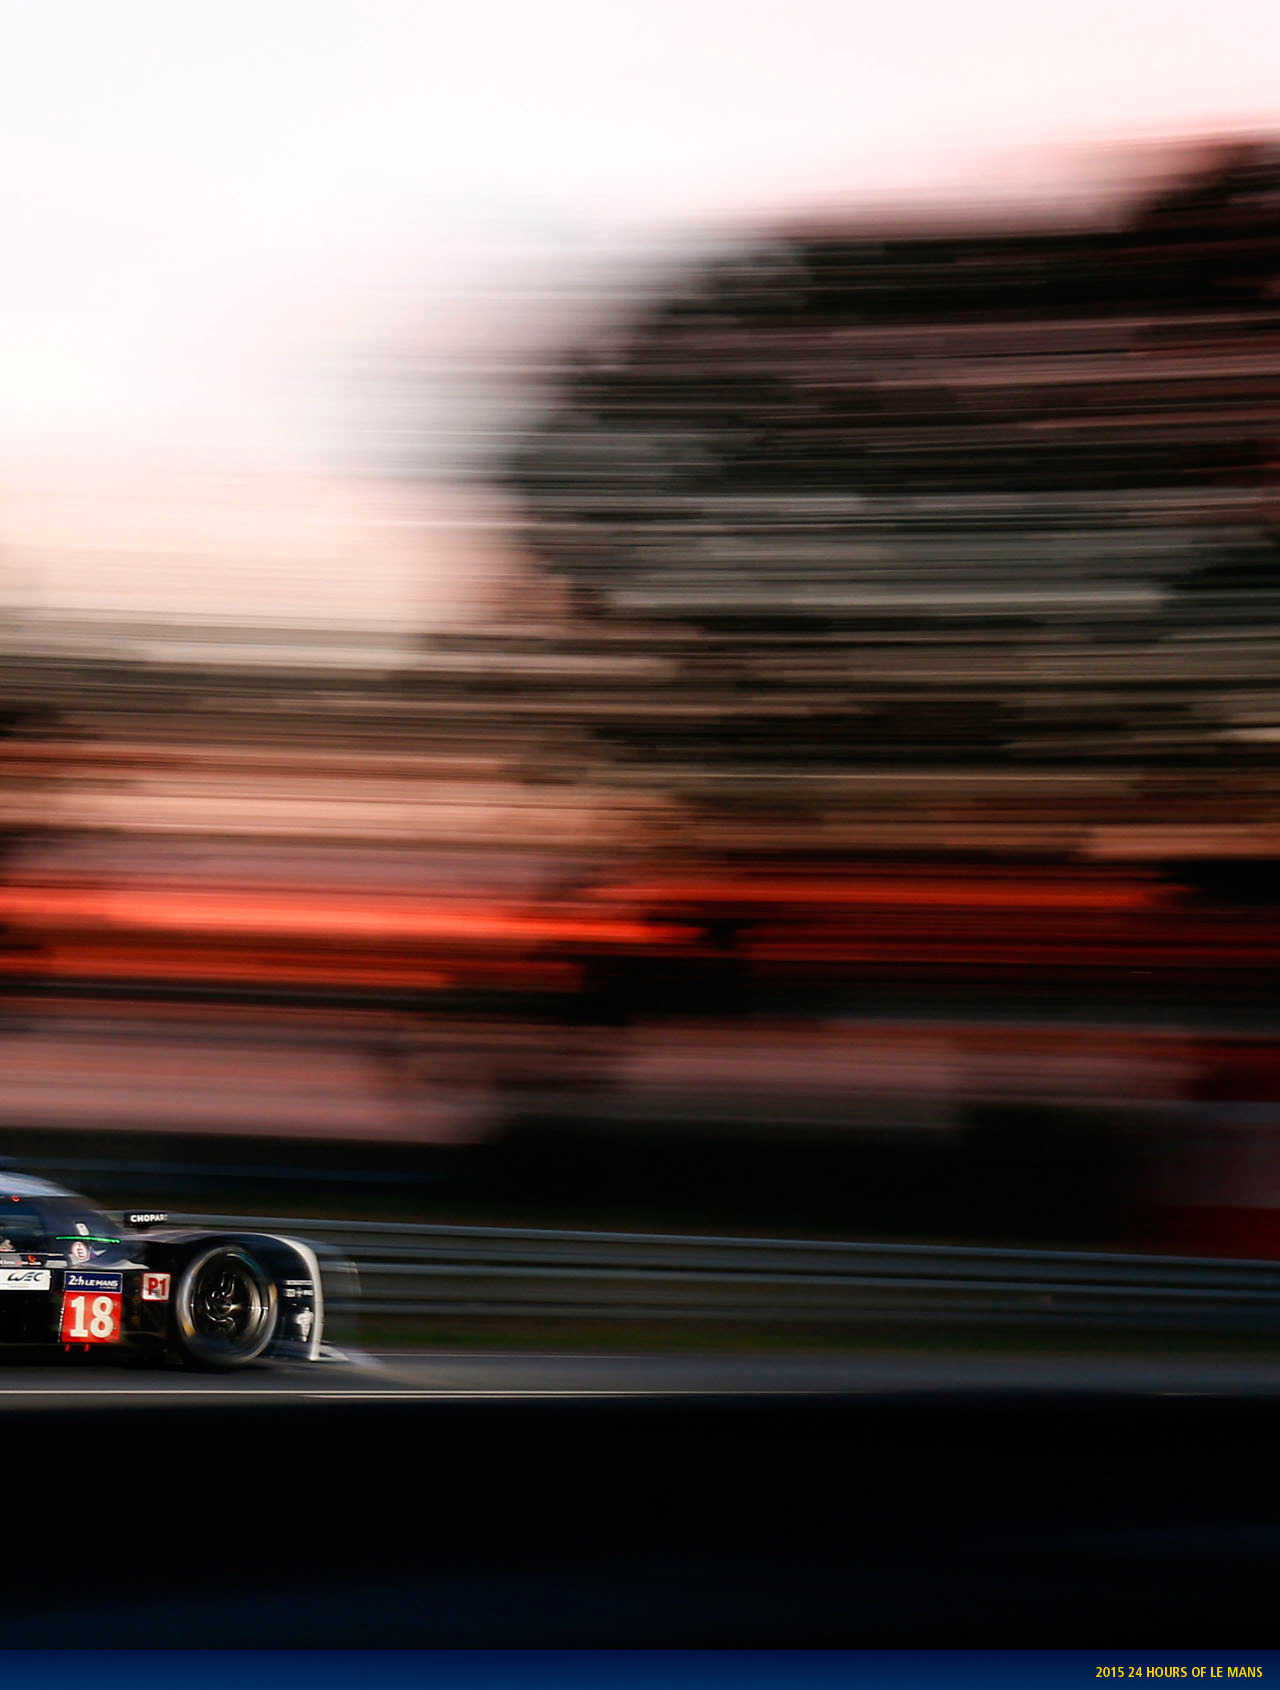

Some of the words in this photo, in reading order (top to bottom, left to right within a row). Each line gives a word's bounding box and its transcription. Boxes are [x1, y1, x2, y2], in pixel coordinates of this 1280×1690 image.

[7, 1271, 44, 1282] WEC
[147, 1277, 168, 1297] P1
[70, 1296, 114, 1338] 18
